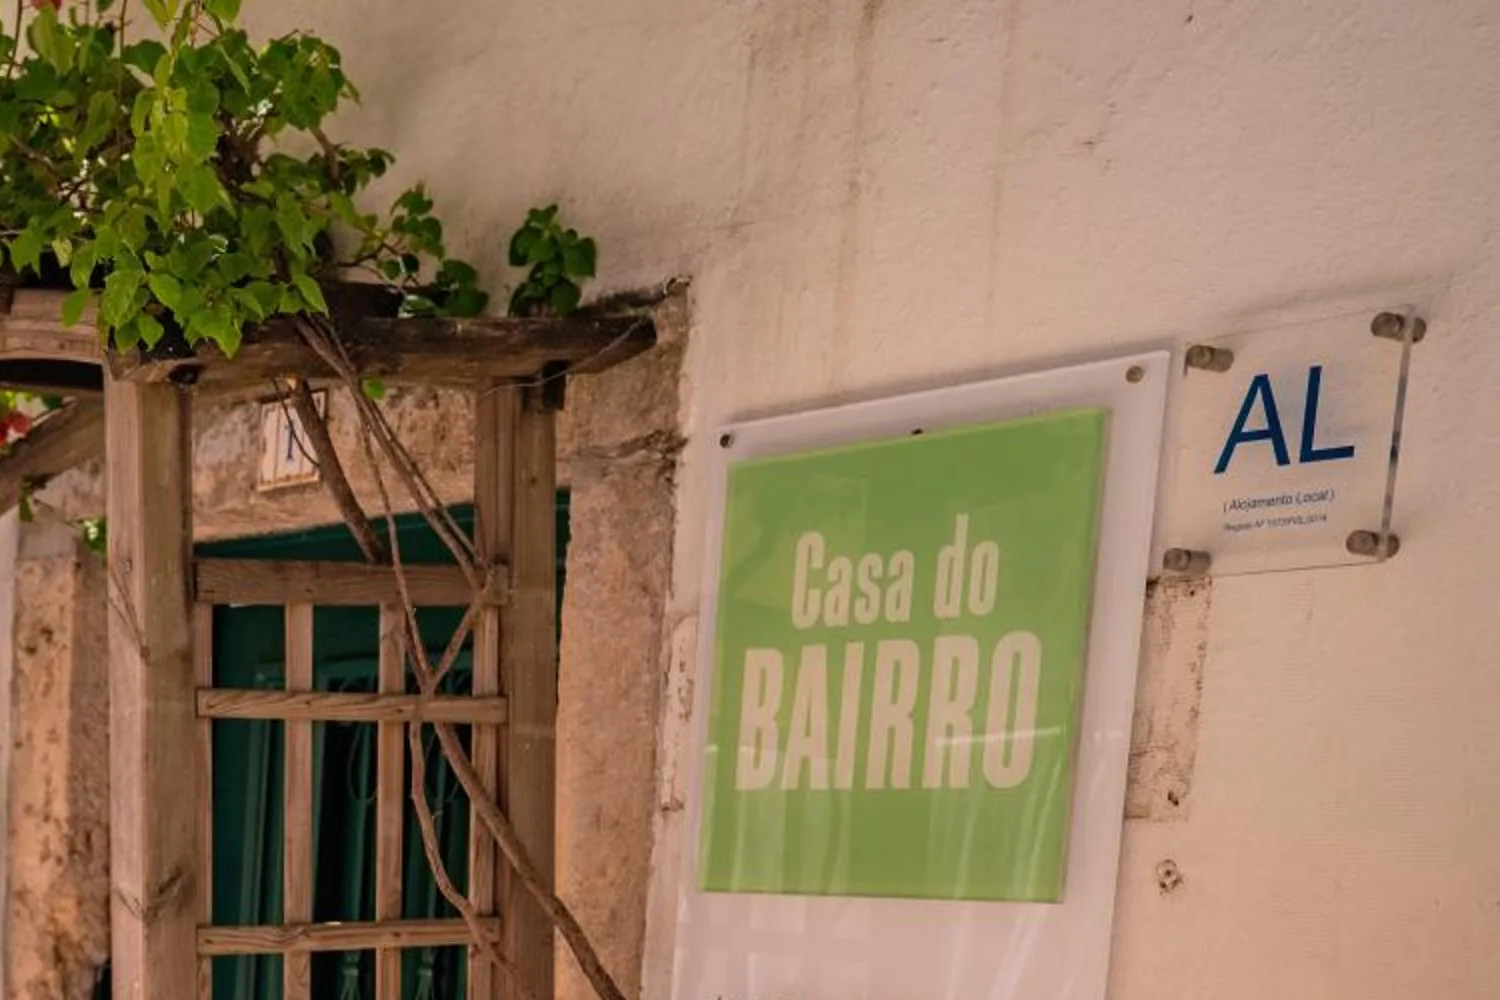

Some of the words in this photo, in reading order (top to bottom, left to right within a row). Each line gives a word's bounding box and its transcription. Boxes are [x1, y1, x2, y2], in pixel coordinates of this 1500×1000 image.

[1214, 365, 1355, 474] AL
[791, 531, 915, 629] Casa
[933, 513, 1000, 619] do
[734, 630, 1042, 791] BAIRRO
